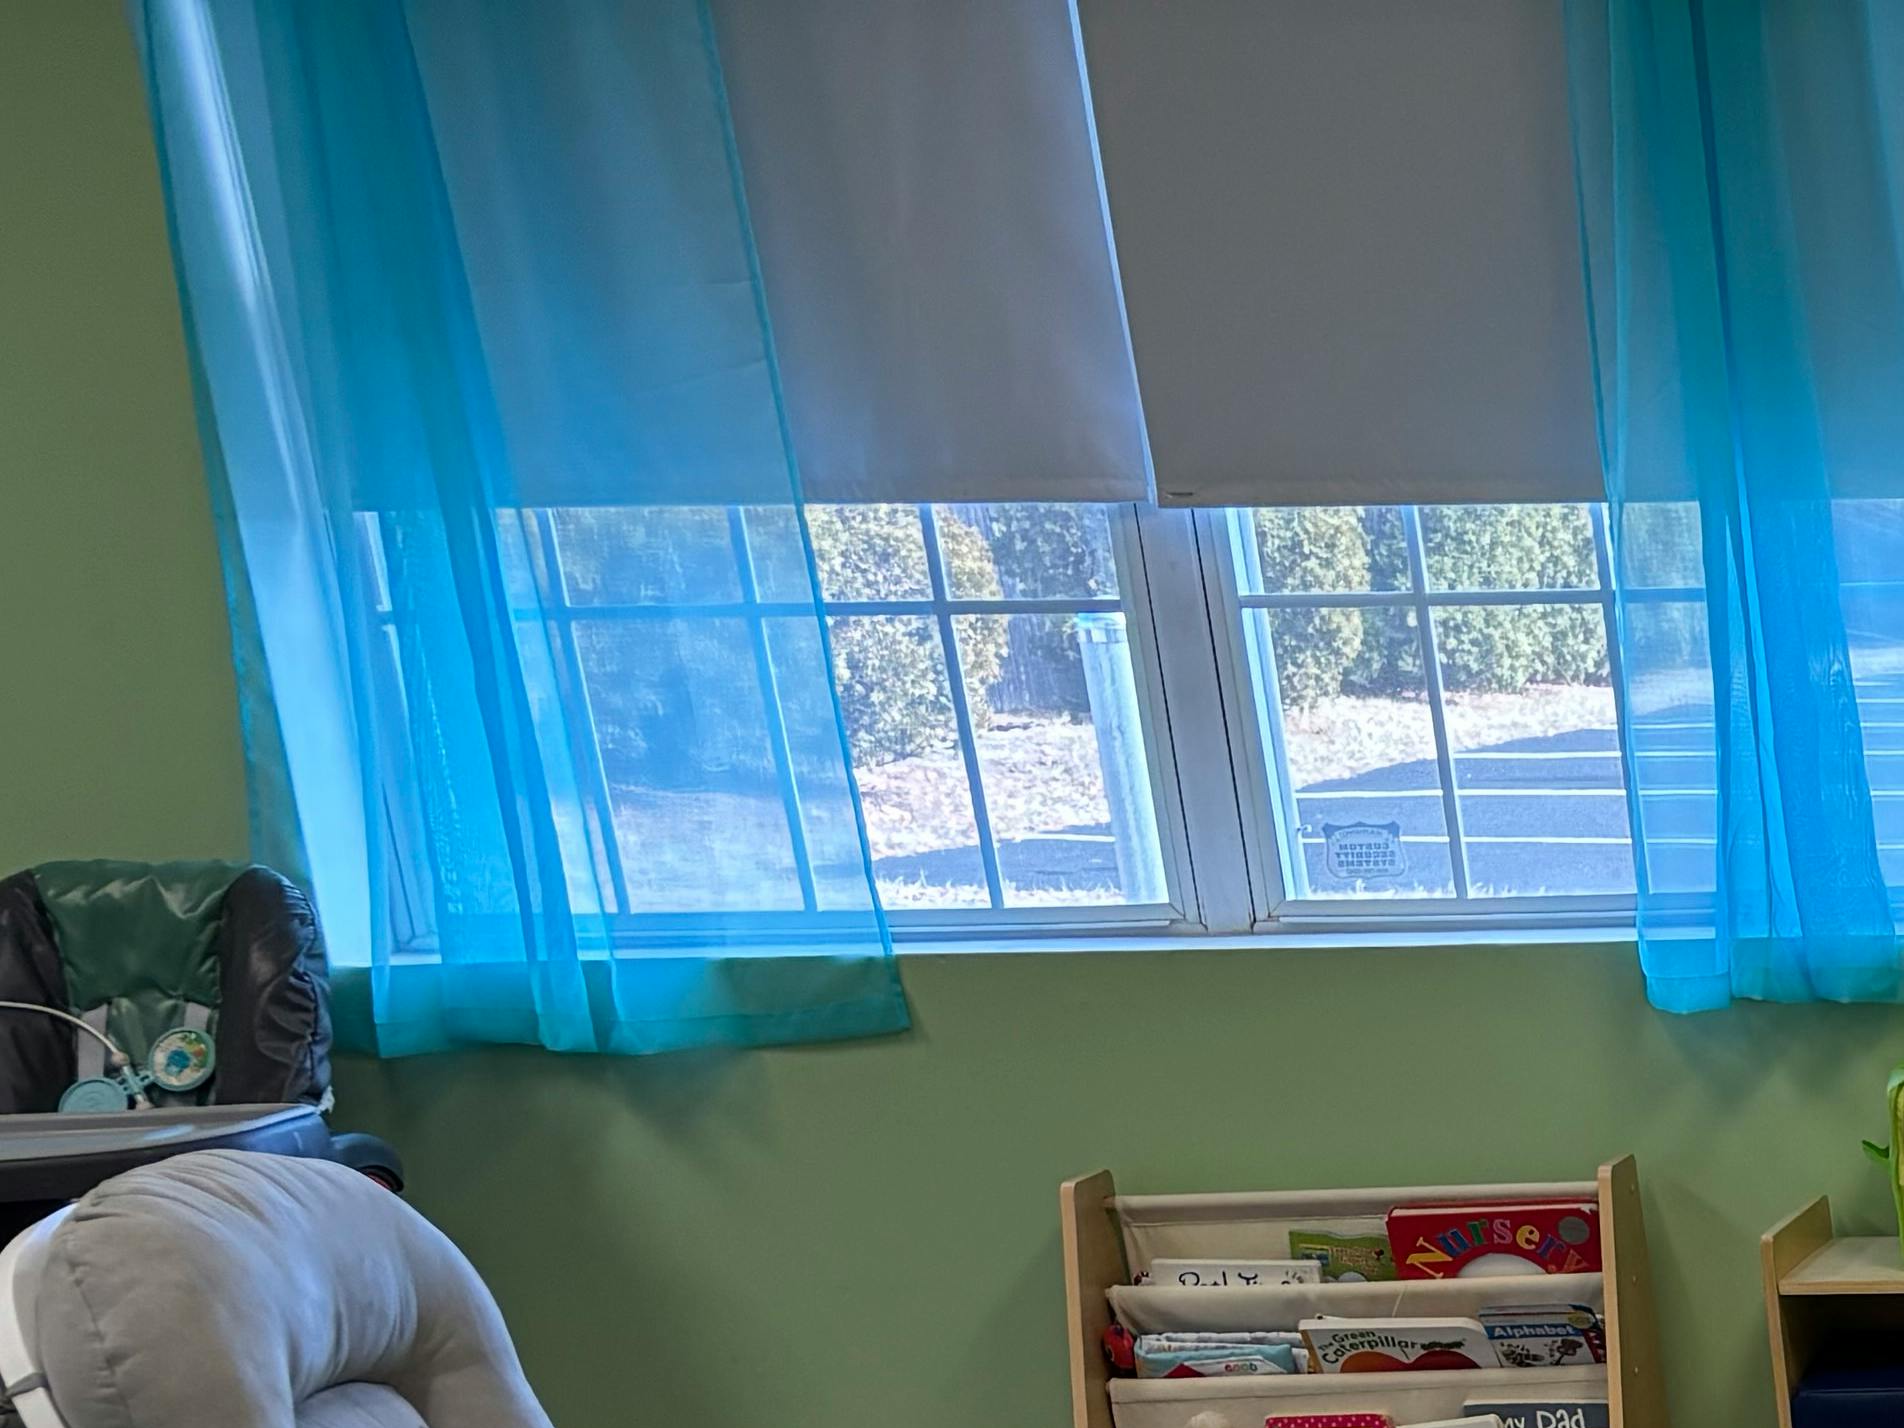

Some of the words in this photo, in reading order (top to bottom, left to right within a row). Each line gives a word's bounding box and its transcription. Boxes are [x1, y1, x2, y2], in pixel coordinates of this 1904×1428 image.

[1406, 1218, 1589, 1279] Nursery
[1332, 1331, 1376, 1344] Green
[1494, 1325, 1575, 1338] Alphabet
[1322, 1335, 1418, 1364] Caterpillar
